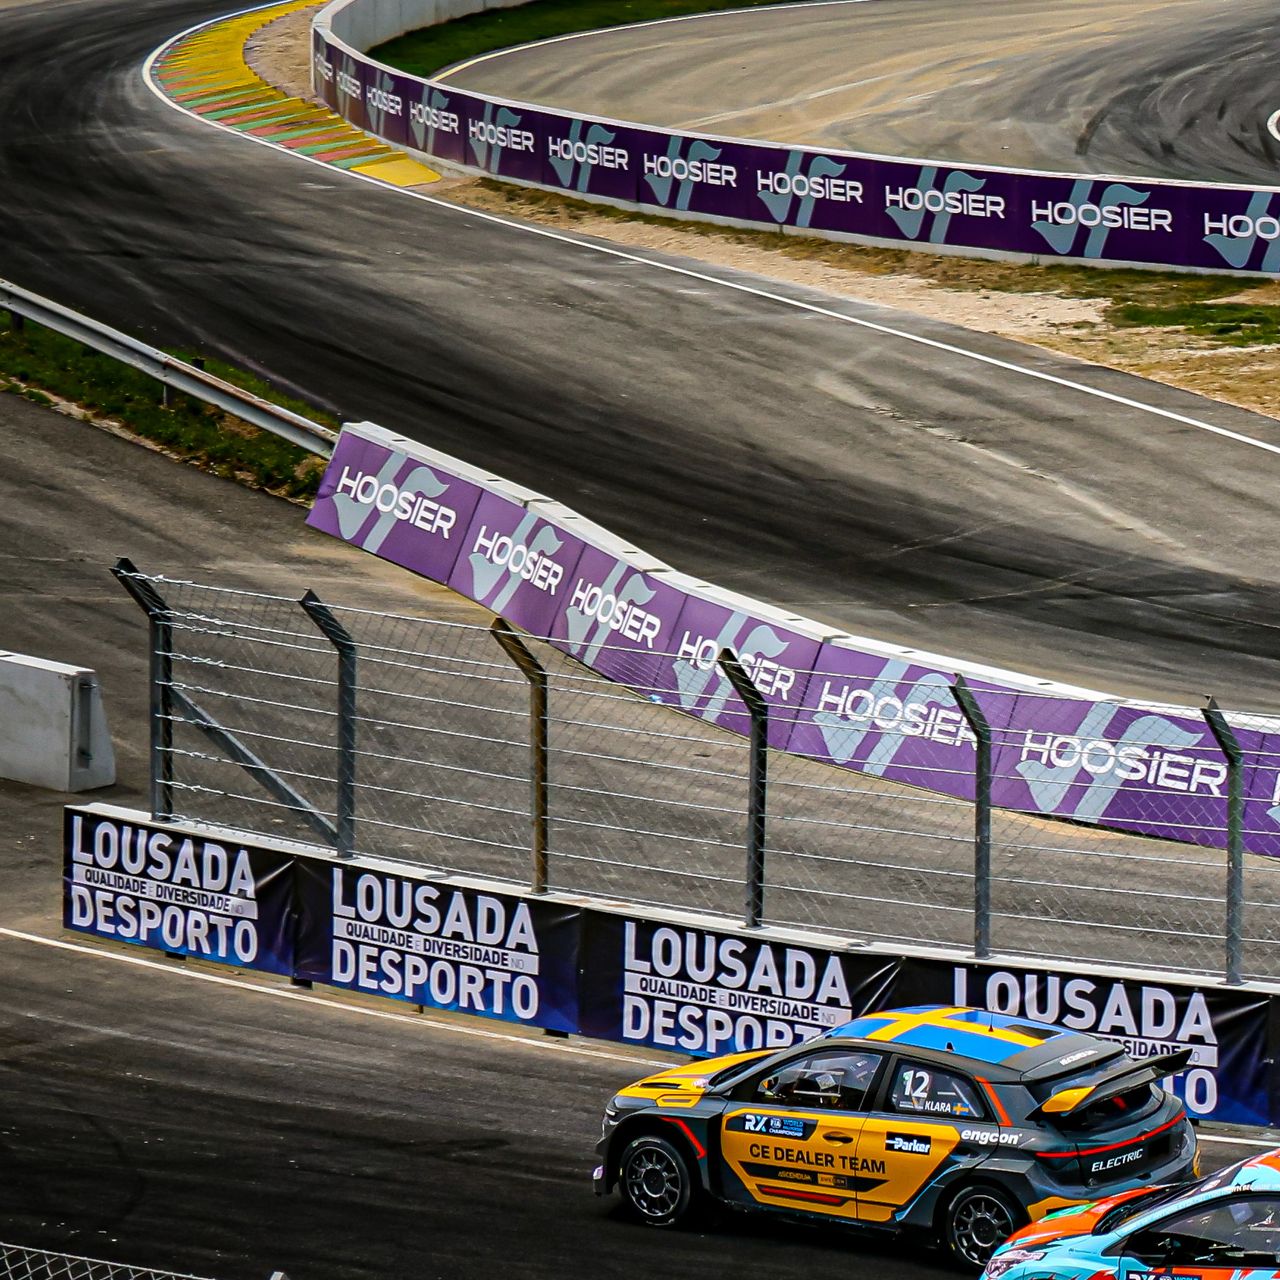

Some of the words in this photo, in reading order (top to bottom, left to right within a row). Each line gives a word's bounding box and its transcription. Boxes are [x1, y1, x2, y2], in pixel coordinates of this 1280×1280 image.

[366, 84, 402, 116] HOOSIER
[410, 100, 460, 134] HOOSIER
[469, 118, 535, 152] HOOSIER
[548, 135, 628, 170] HOOSIER
[644, 153, 737, 187] HOOSIER
[757, 169, 863, 203] HOOSIER
[885, 185, 1005, 219] HOOSIER
[1031, 199, 1173, 233] HOOSIER
[336, 466, 456, 540] HOOSIER
[473, 525, 563, 596] HOOSIER
[570, 578, 660, 649] HOOSIER
[1020, 728, 1227, 797] HOOSIER
[72, 814, 257, 898] LOUSADA
[84, 868, 147, 896] QUALIDADE
[155, 882, 231, 914] DIVERSIDADE
[71, 888, 260, 964] DESPORTO
[332, 867, 538, 954] LOUSADA
[345, 920, 414, 950] QUALIDADE
[422, 939, 510, 967] DIVERSIDADE
[331, 939, 539, 1020] DESPORTO
[623, 920, 853, 1009] LOUSADA
[638, 976, 717, 1003] QUALIDADE
[727, 994, 820, 1023] DIVERSIDADE
[954, 967, 1218, 1044] LOUSADA
[902, 1069, 930, 1098] 12
[745, 1114, 767, 1132] RX
[924, 1100, 951, 1113] KLARA
[893, 1137, 931, 1154] Parker
[961, 1129, 1020, 1146] engcon
[749, 1143, 771, 1159] CE
[774, 1146, 835, 1168] DEALER
[838, 1156, 887, 1175] TEAM
[1091, 1148, 1144, 1173] ELECTRIC
